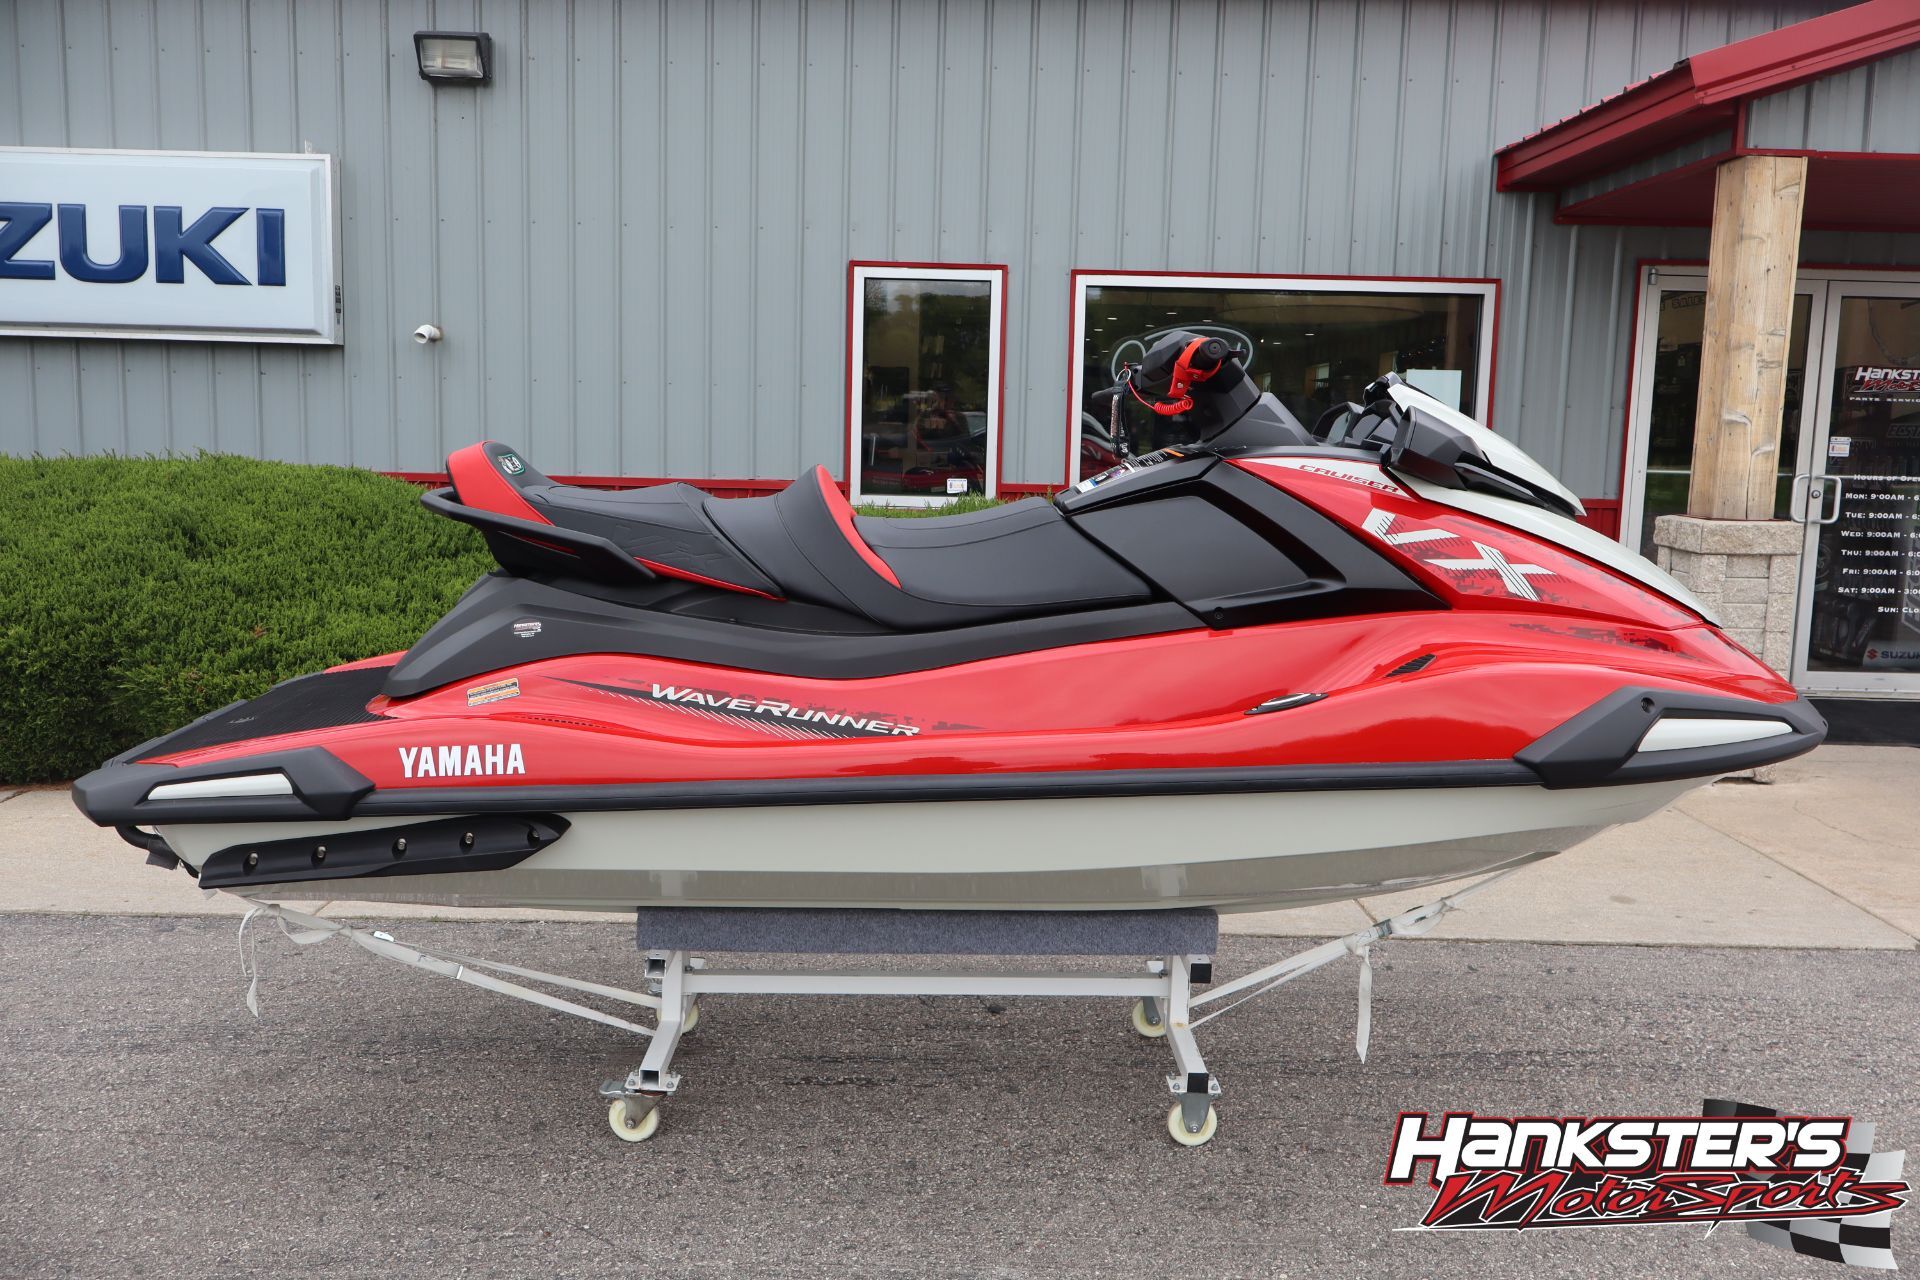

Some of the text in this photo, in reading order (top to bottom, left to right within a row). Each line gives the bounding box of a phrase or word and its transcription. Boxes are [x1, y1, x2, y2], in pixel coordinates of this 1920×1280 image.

[0, 201, 287, 286] ZUKI
[1299, 464, 1399, 493] CRUISER
[1870, 493, 1905, 501] 9:00AM
[1361, 508, 1557, 602] VX
[1863, 568, 1897, 576] 9:00AM
[1861, 587, 1895, 595] 9:00AM
[398, 743, 526, 778] YAMAHA
